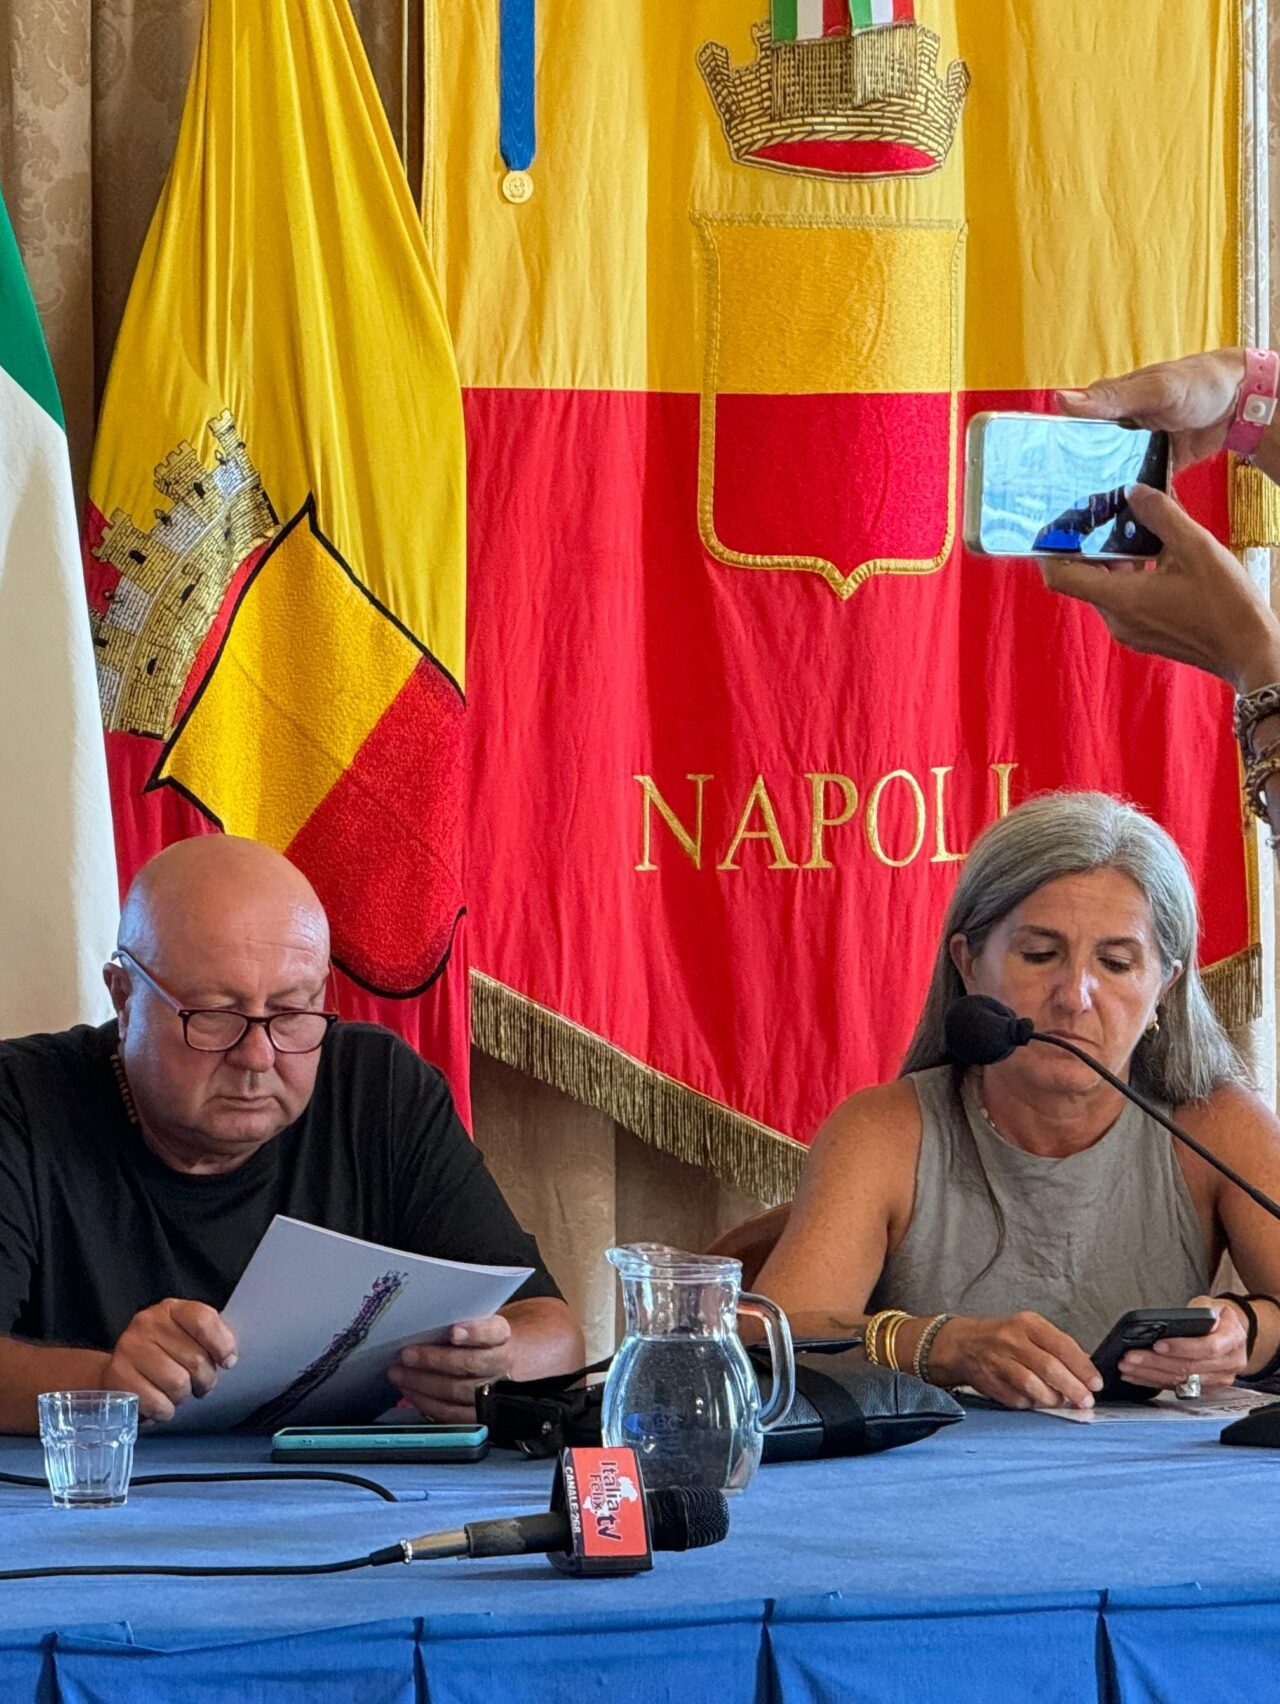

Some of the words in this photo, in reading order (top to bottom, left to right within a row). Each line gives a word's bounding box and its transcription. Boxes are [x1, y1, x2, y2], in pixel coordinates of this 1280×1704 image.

[632, 762, 1019, 870] NAPOLI
[564, 1466, 578, 1511] CANALE
[601, 1462, 622, 1511] Italia
[570, 1512, 581, 1533] 268
